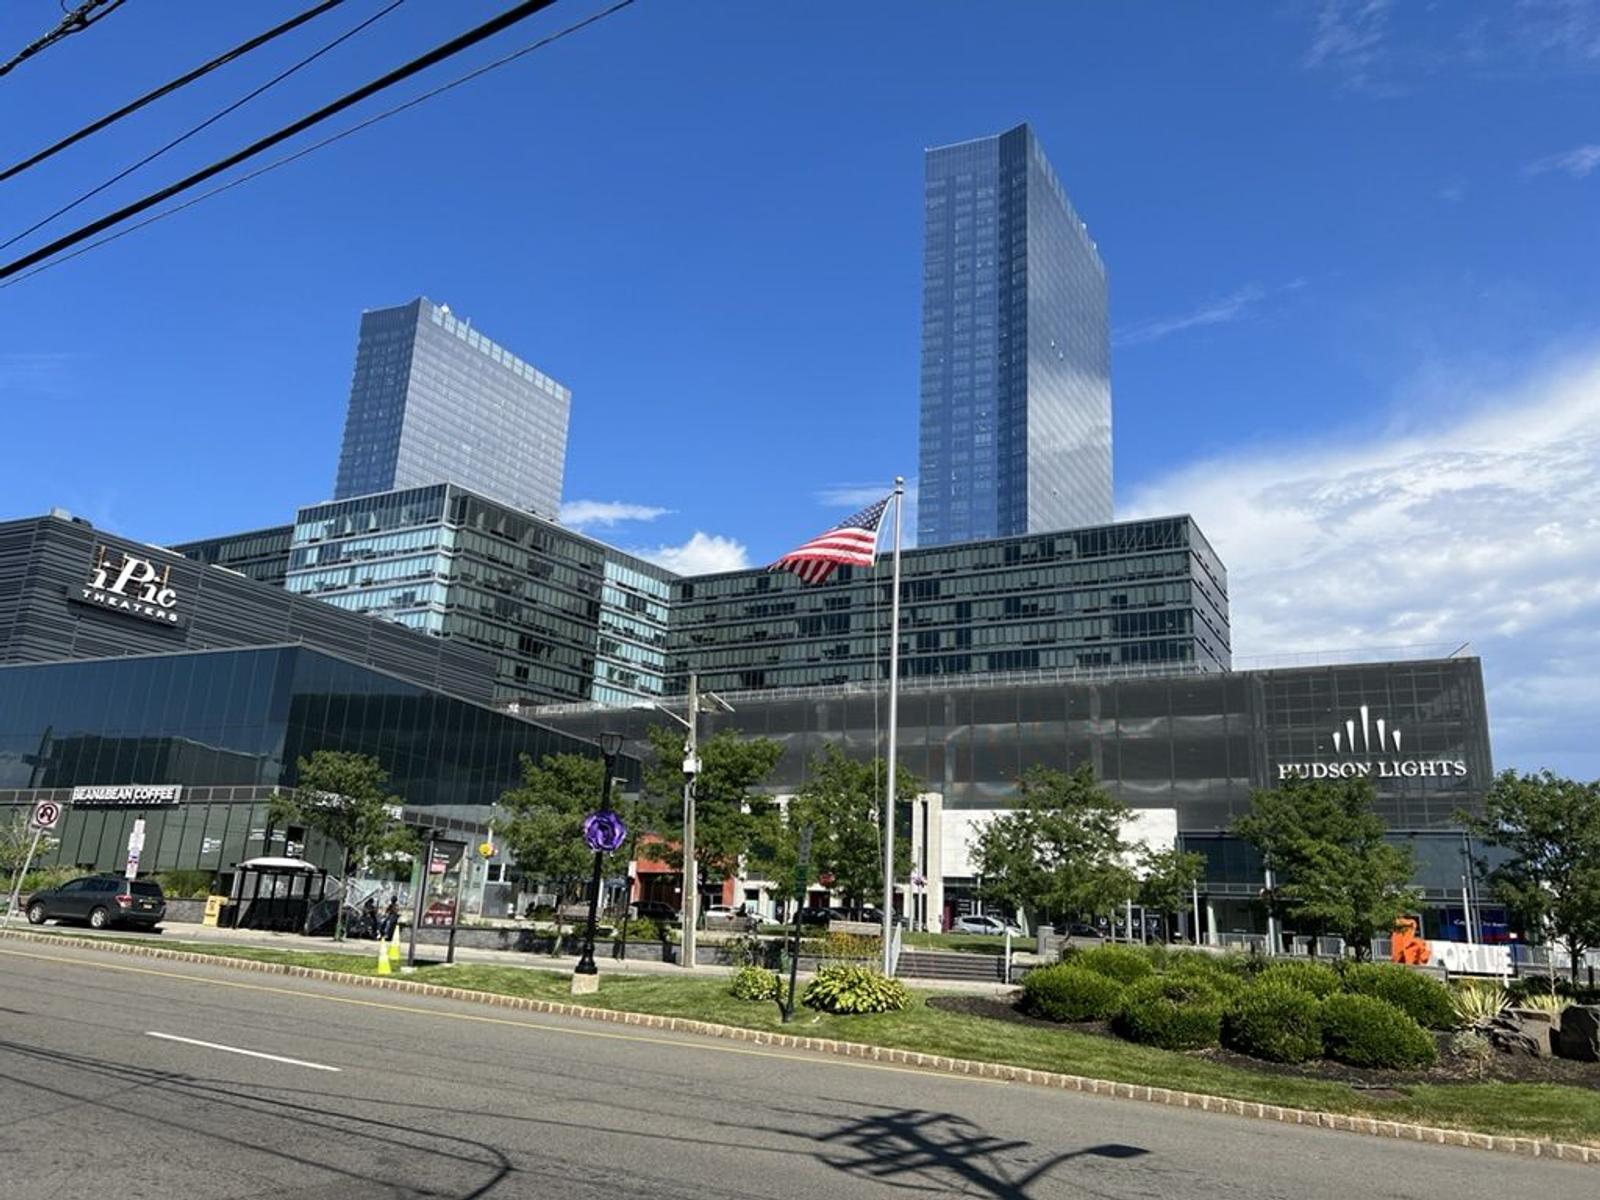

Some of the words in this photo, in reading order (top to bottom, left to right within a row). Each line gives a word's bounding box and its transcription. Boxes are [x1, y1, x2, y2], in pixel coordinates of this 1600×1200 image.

[87, 553, 176, 607] iPic
[82, 589, 178, 622] THEATERS
[1278, 761, 1371, 779] HUDSON
[1378, 760, 1467, 777] LIGHTS
[134, 787, 175, 800] COFFEE
